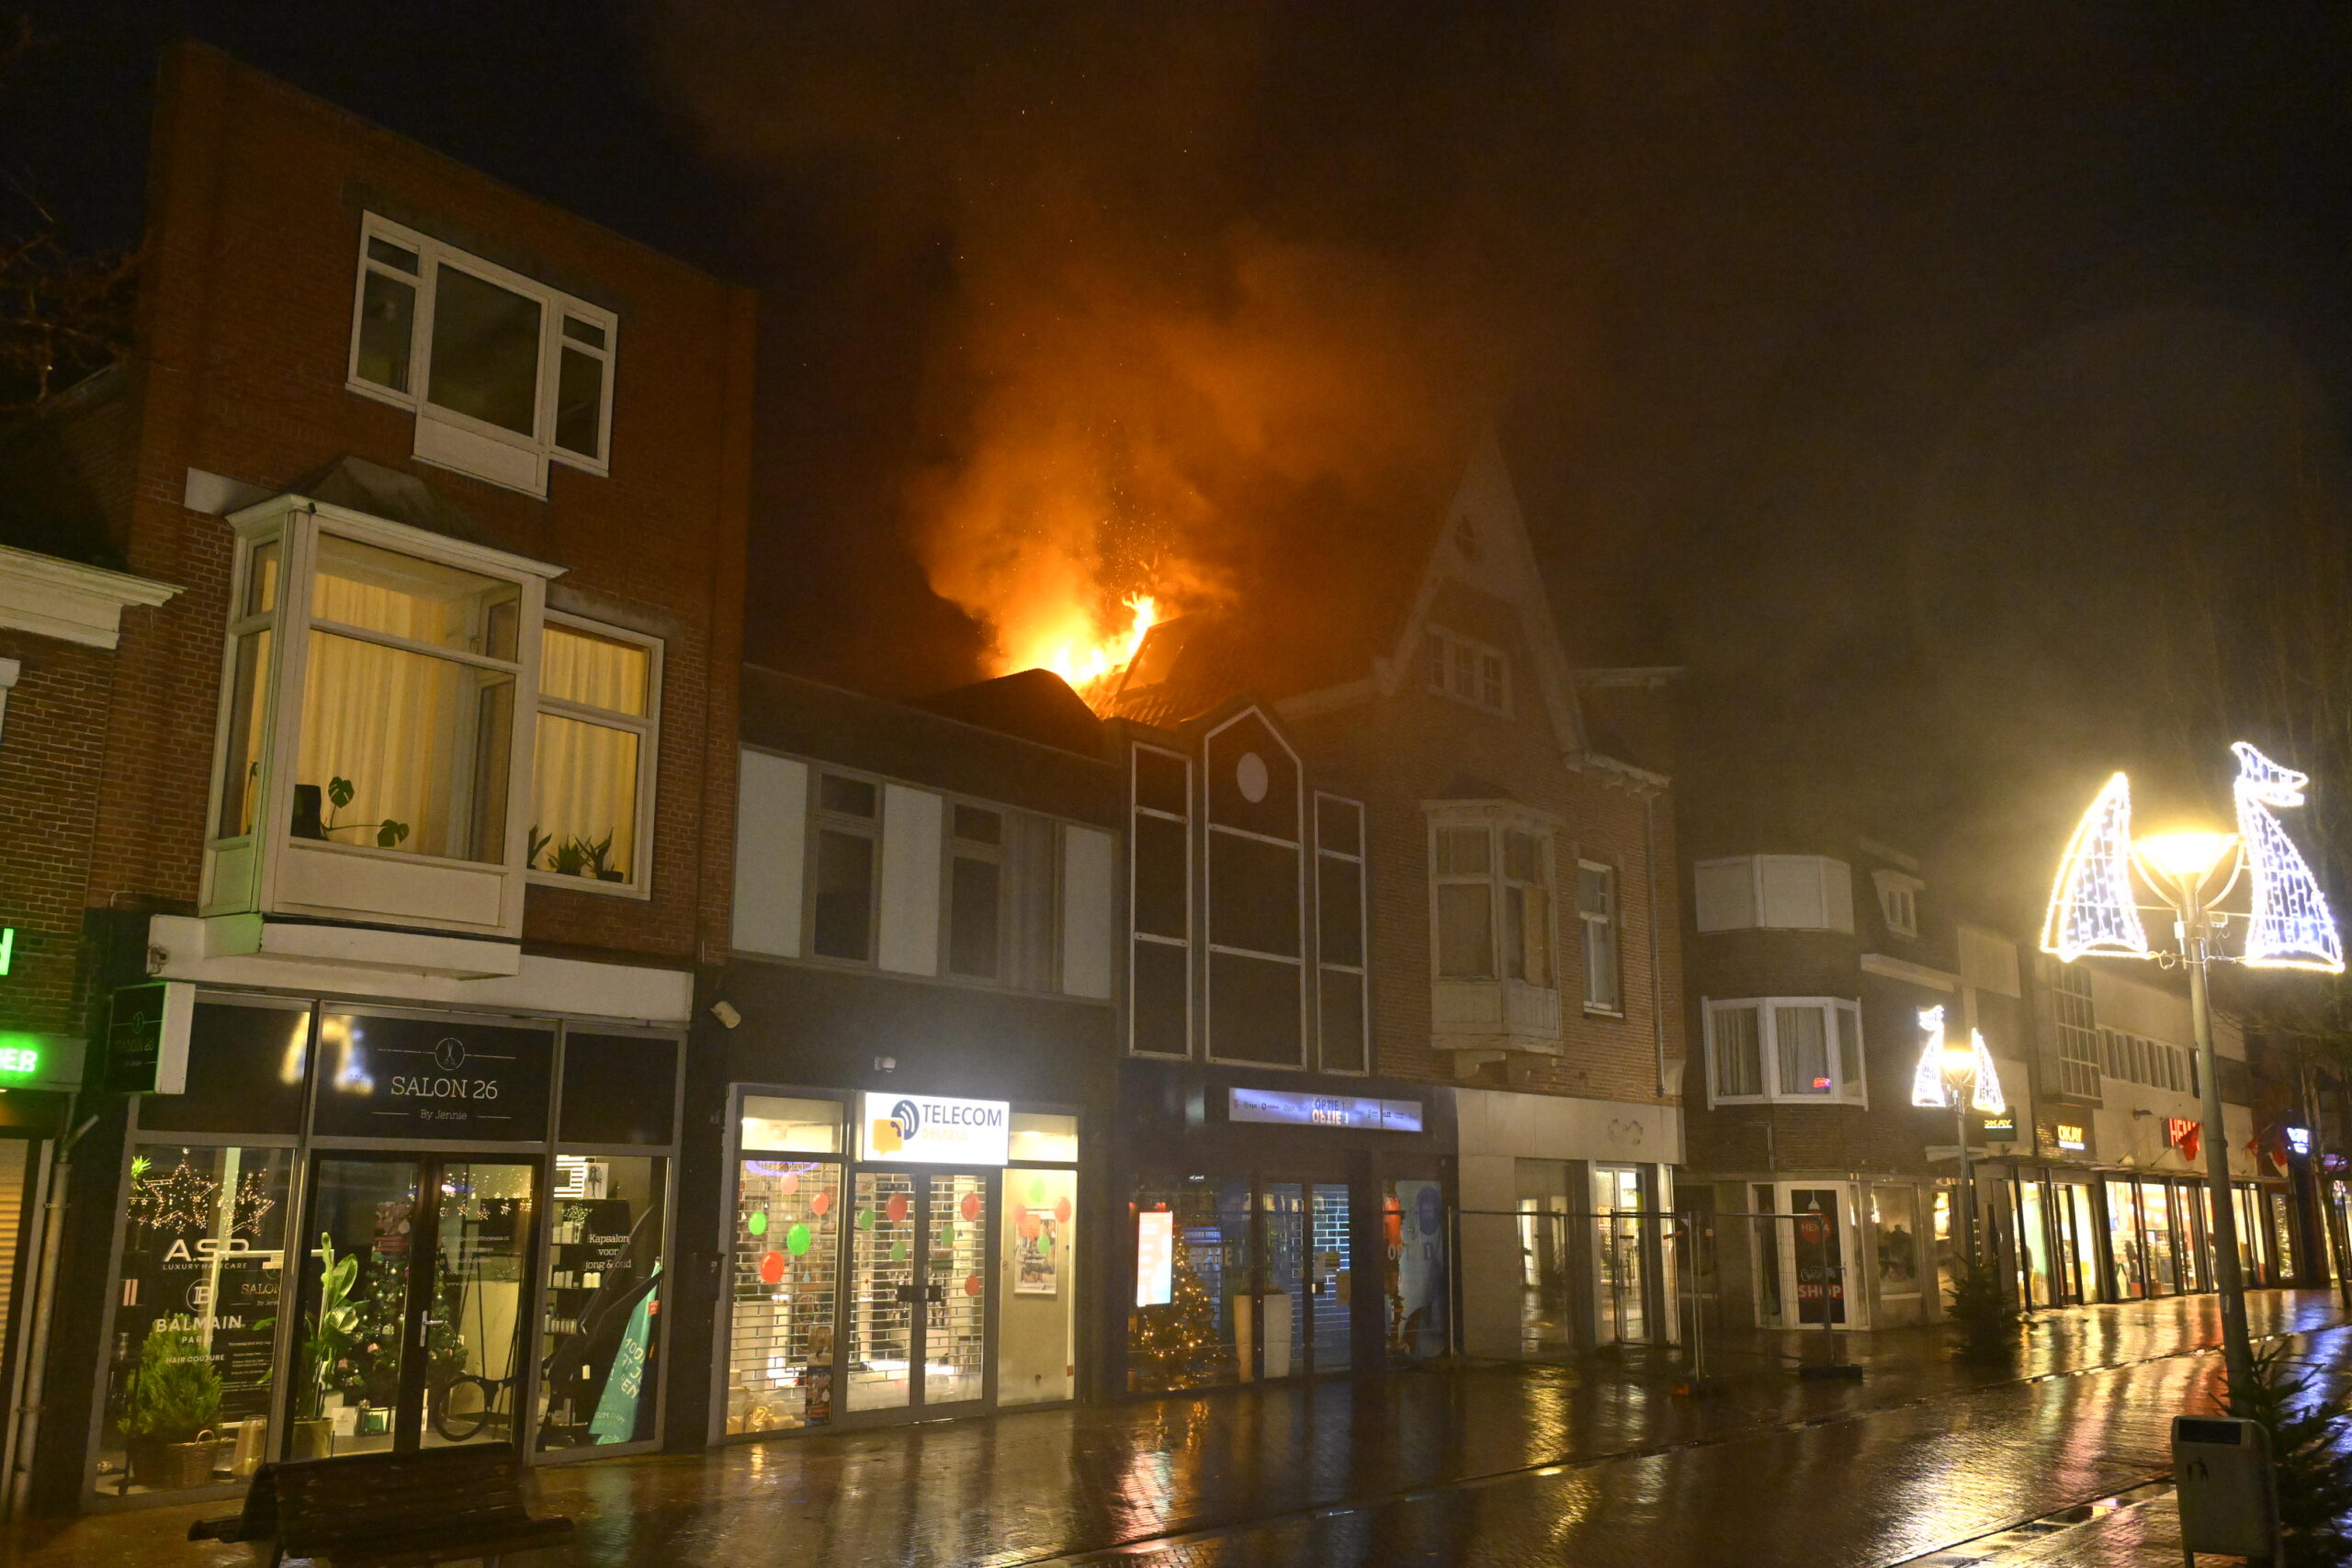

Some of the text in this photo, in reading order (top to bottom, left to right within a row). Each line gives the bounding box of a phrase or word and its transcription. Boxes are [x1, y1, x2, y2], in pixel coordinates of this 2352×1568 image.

[391, 1076, 499, 1100] SALON 26
[420, 1109, 468, 1121] By Jennie
[922, 1103, 1002, 1127] TELECOM
[589, 1234, 630, 1246] Kapsalon
[597, 1248, 619, 1257] voor
[163, 1262, 199, 1270] LUXURY
[584, 1258, 632, 1271] jong & oud
[155, 1314, 243, 1333] BALMAIN
